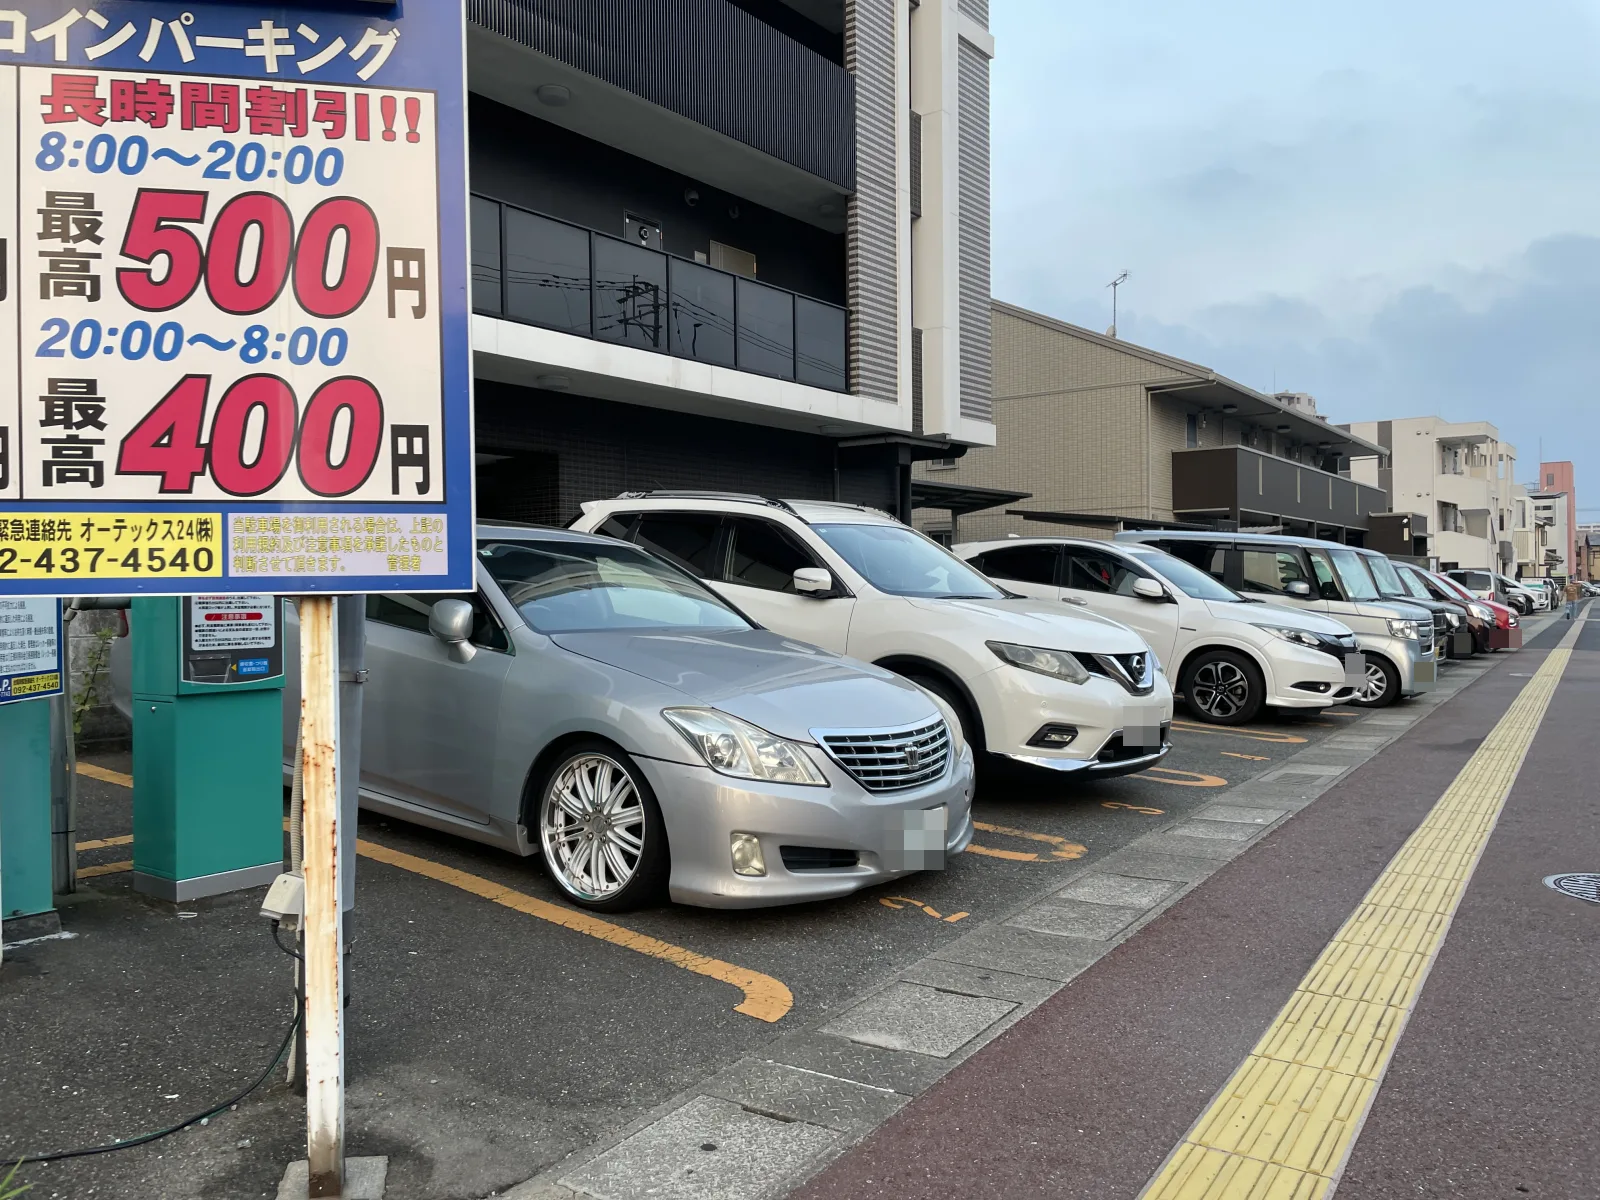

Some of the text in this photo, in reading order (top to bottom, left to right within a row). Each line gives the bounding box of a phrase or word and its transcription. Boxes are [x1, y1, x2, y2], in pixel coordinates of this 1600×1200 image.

[0, 8, 401, 81] コインパーキング
[40, 74, 421, 144] 長時間割引!!
[37, 190, 104, 302] 最高
[38, 377, 108, 488] 最高
[233, 554, 422, 572] 判断させて頂きます。 管理者
[13, 681, 59, 695] 092-437-4540
